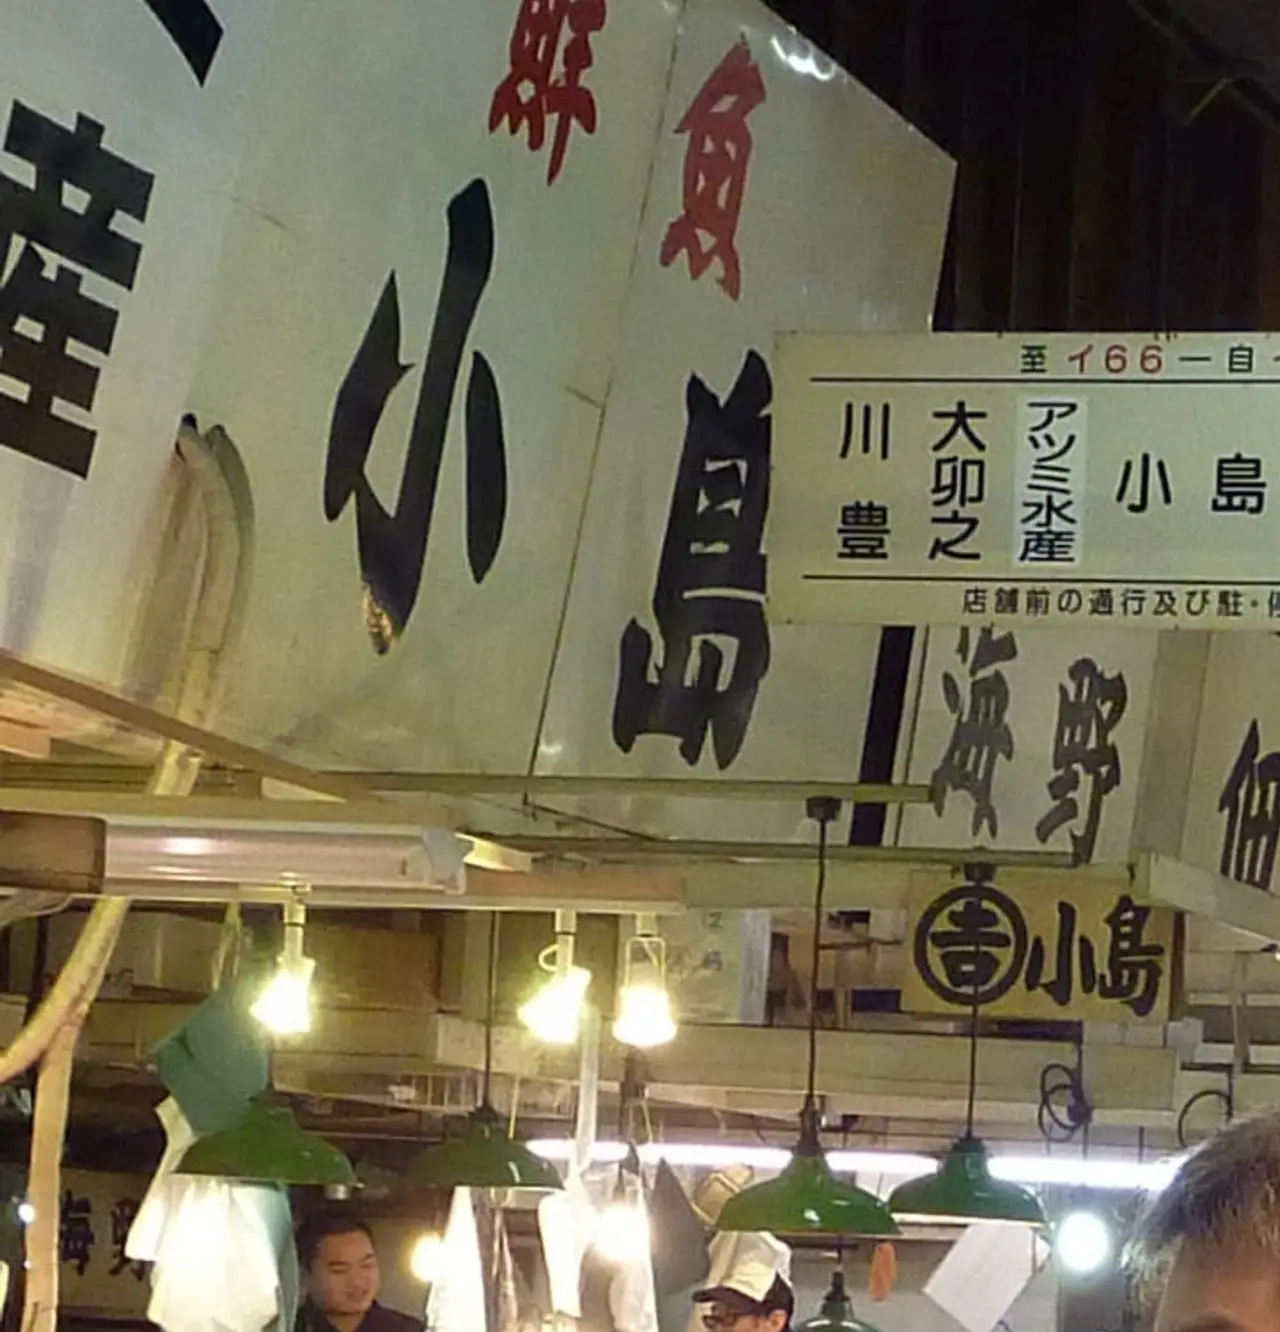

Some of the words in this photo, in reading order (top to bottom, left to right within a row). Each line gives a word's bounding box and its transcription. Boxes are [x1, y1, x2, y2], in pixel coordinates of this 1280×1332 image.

[837, 402, 892, 560] 川豊
[1018, 401, 1078, 563] アツミ水産
[1115, 452, 1267, 515] 小島
[1025, 894, 1166, 1017] 小島
